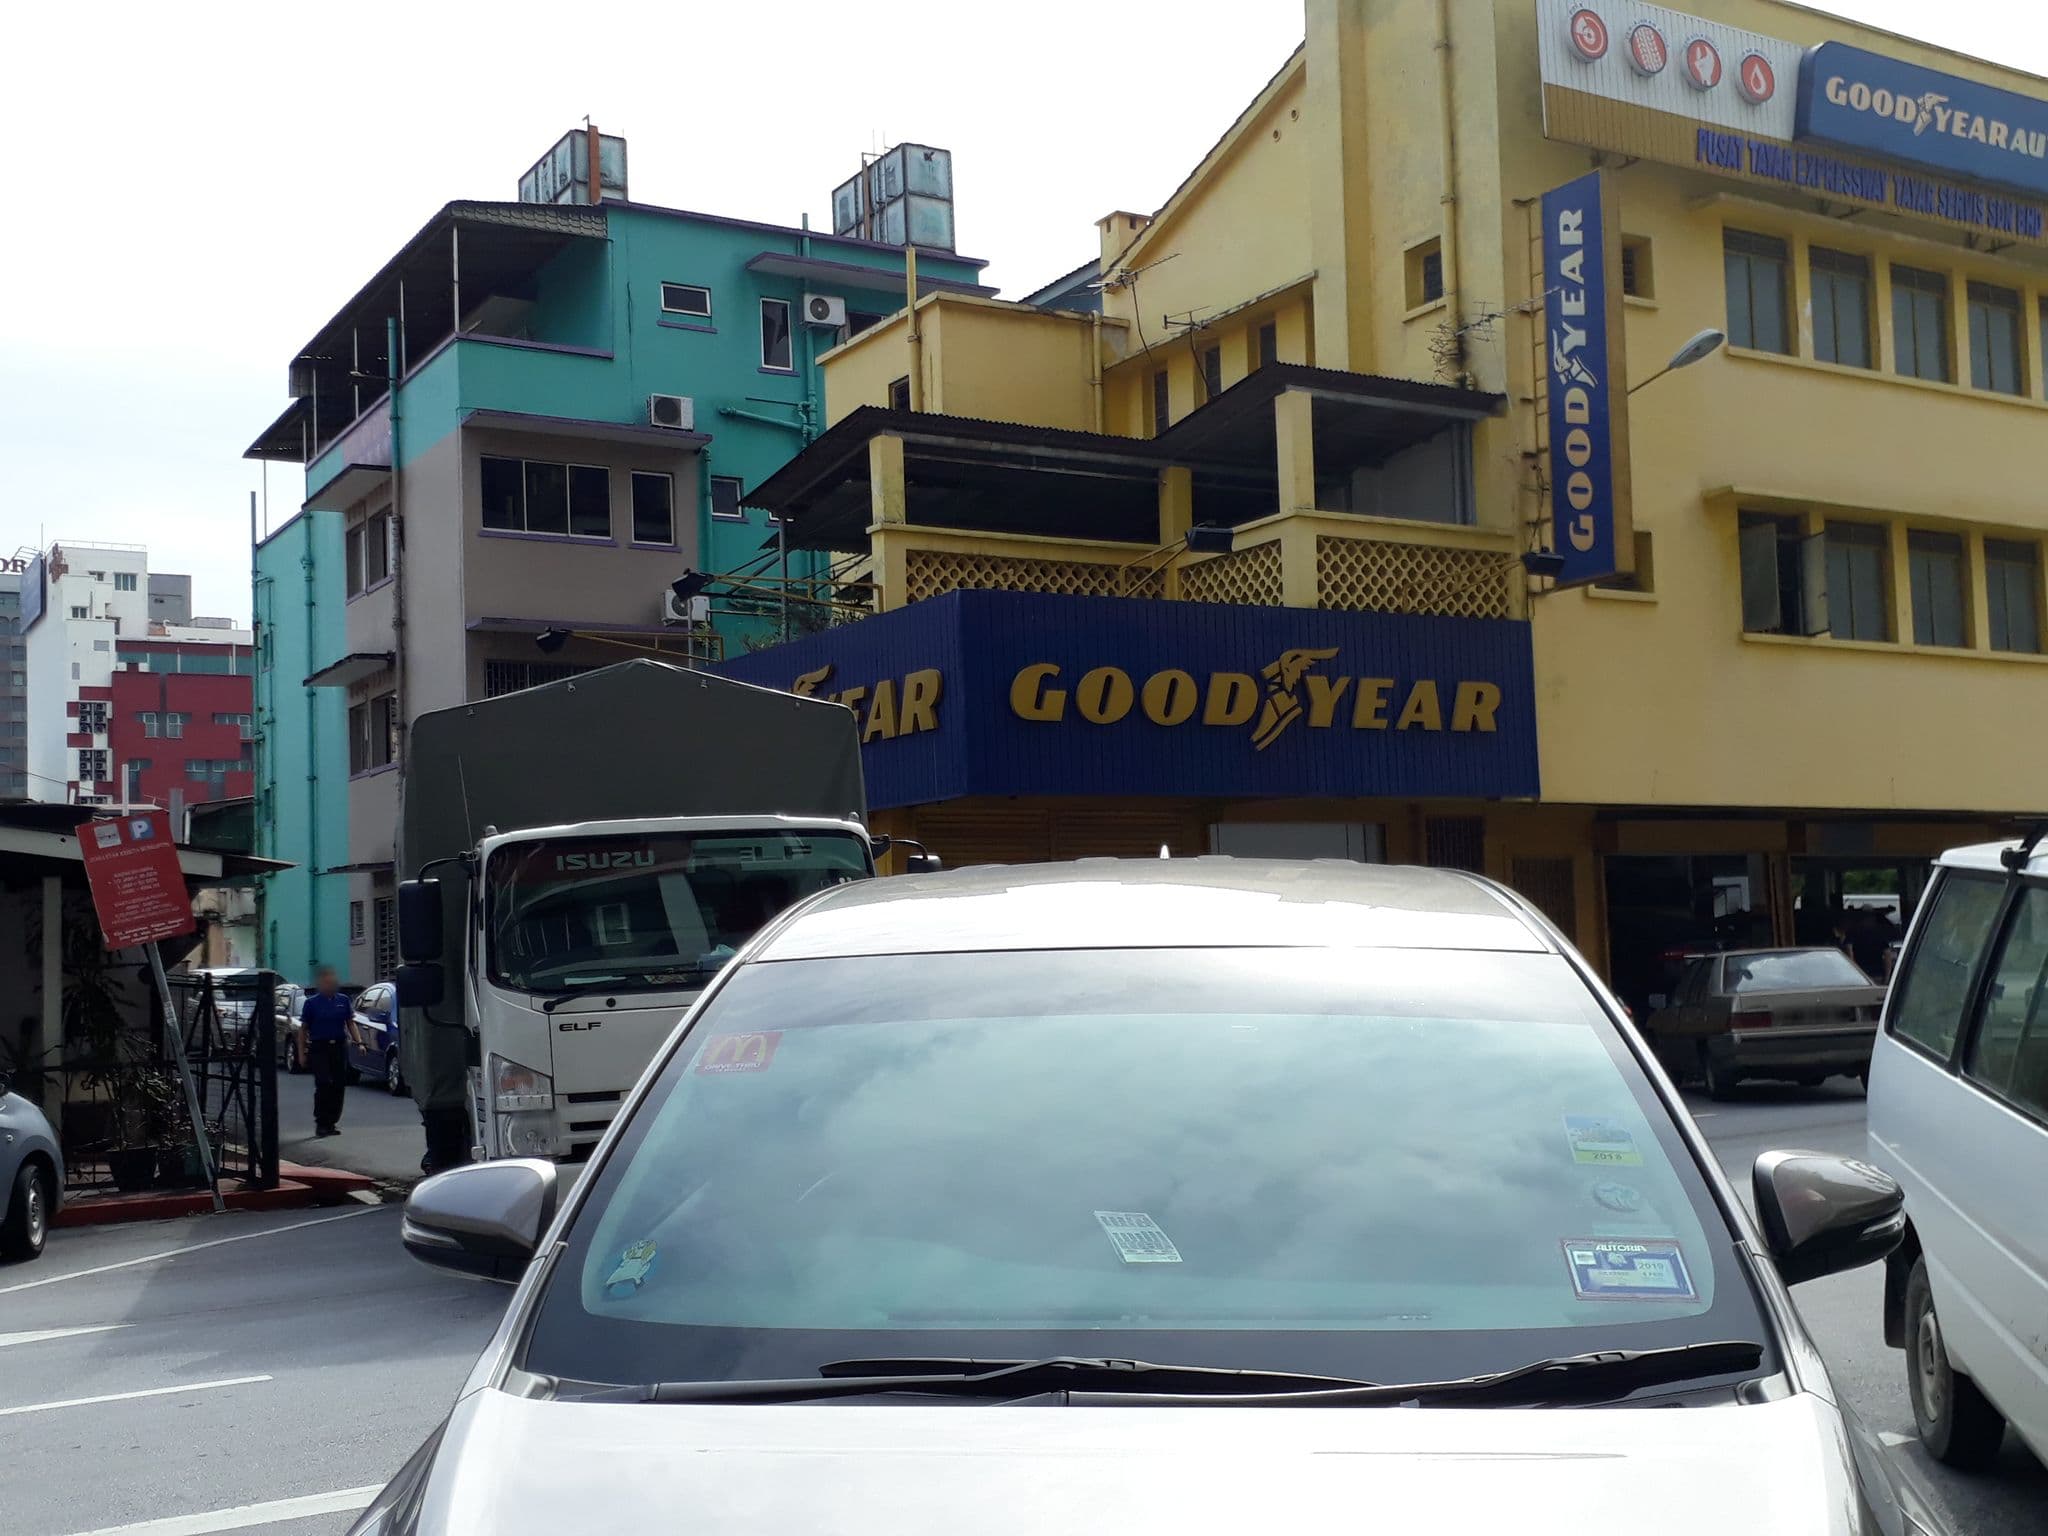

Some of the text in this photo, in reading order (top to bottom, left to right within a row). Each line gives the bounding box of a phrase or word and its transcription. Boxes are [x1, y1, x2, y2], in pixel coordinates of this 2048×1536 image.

[1826, 75, 2048, 159] GOODYEAR AU
[1697, 127, 1744, 170] PUSAT
[1748, 140, 1793, 182] TAYAR
[1795, 151, 1888, 204] EXPRESSWAY
[1936, 188, 1986, 225] SERVIS
[1987, 199, 2012, 233] SDN
[2016, 205, 2043, 239] BHD
[1556, 206, 1597, 553] GOODYEAR
[1009, 656, 1503, 735] GOODYEAR
[556, 850, 656, 871] ISUZU
[558, 1021, 602, 1032] ELF
